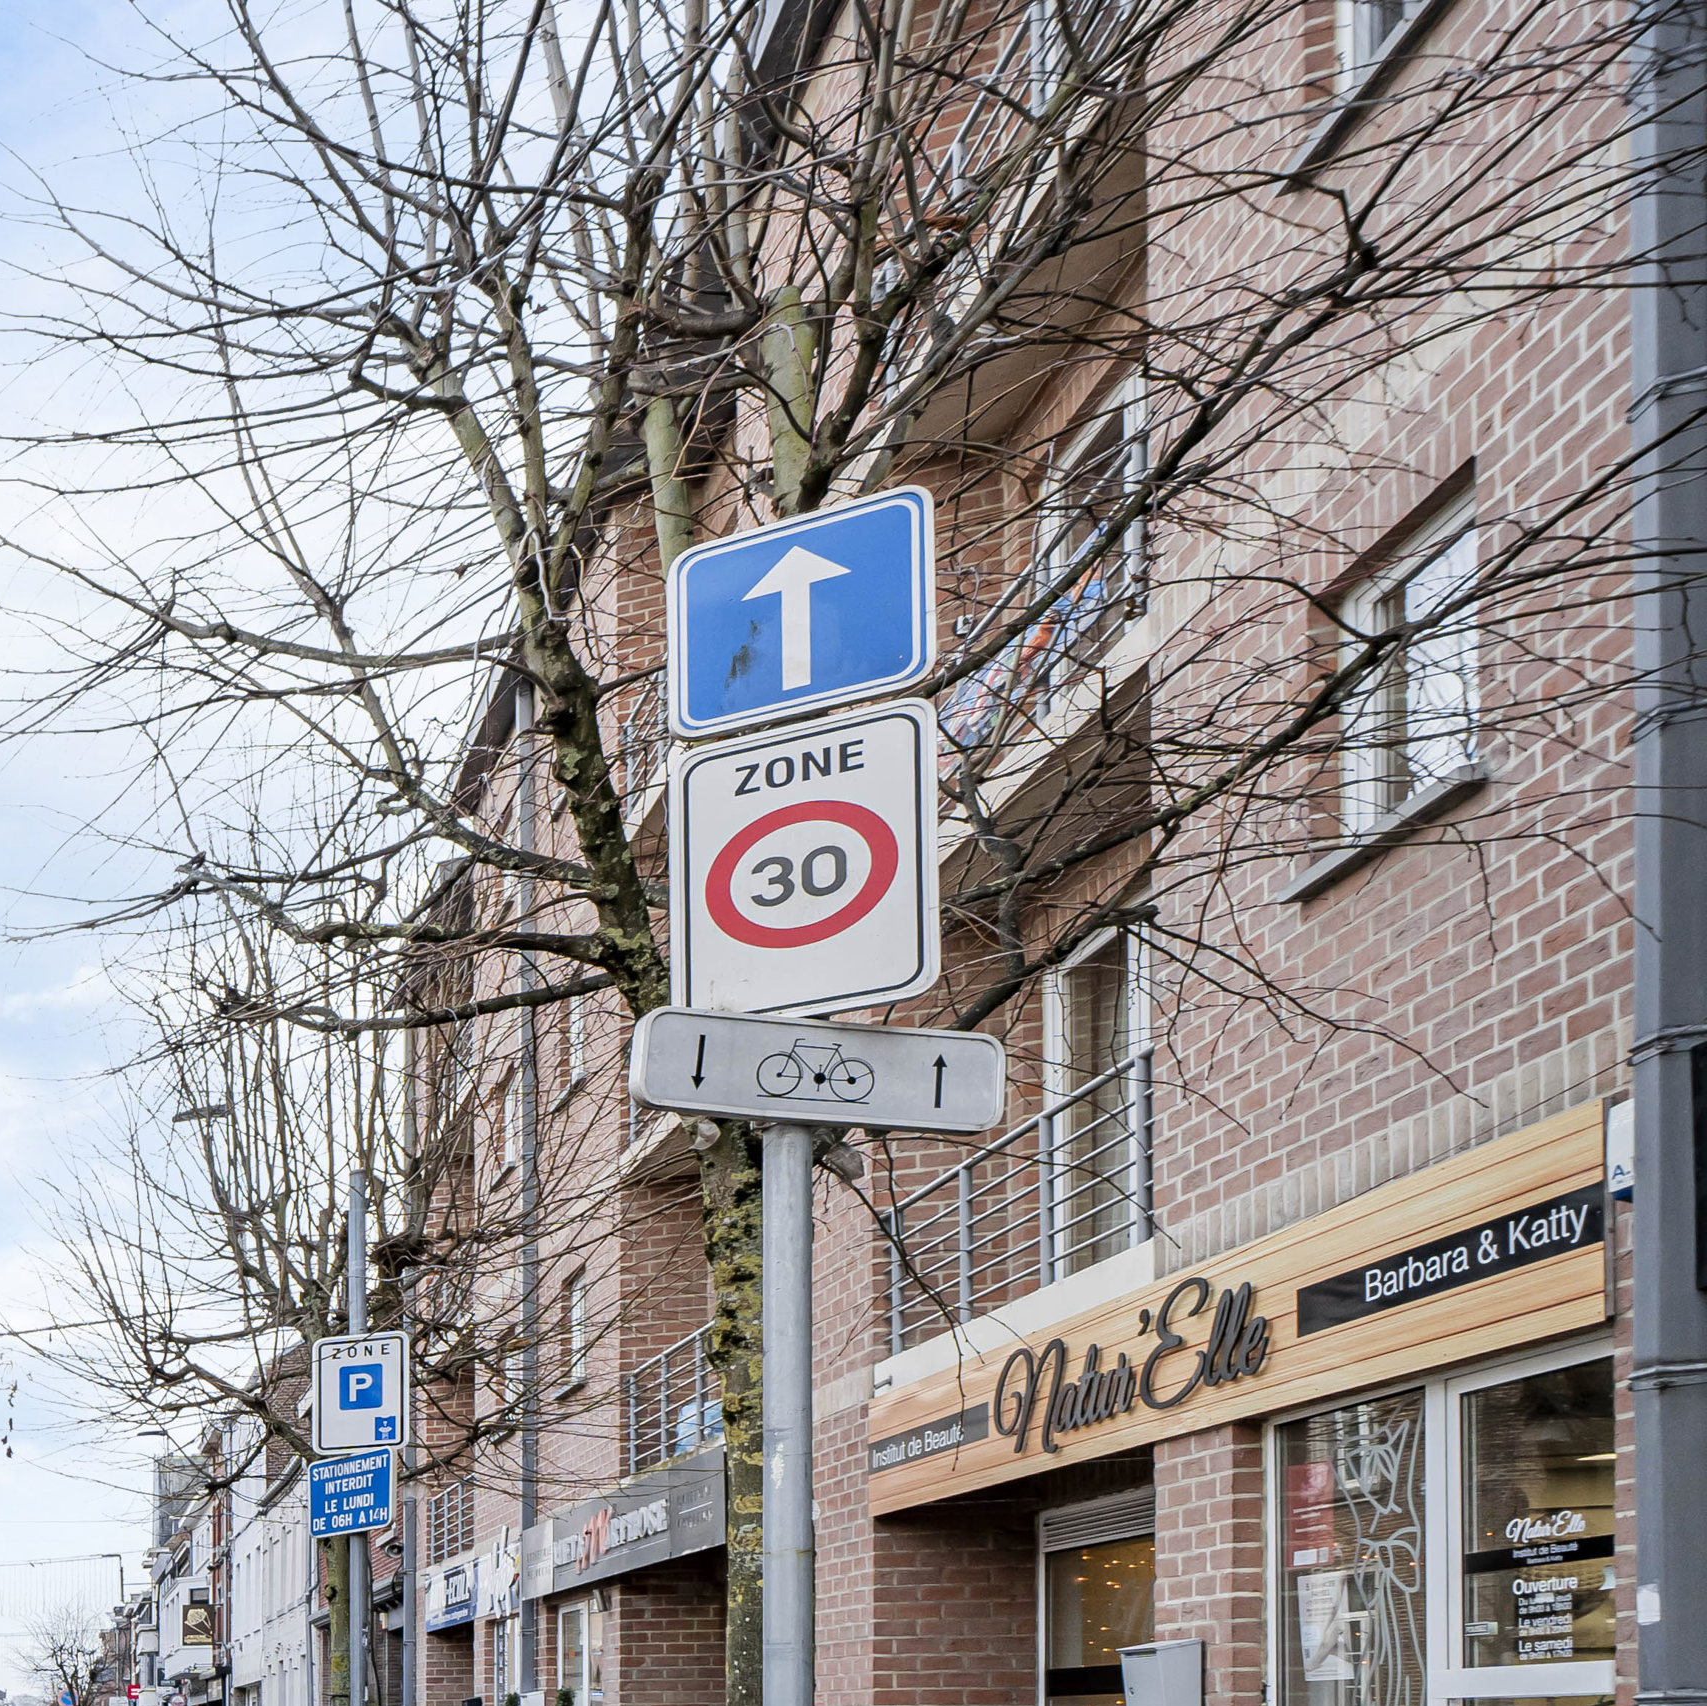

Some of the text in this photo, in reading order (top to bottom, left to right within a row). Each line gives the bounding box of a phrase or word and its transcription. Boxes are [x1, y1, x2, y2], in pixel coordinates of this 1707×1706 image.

[734, 738, 865, 797] ZONE
[750, 845, 847, 908] 30
[1365, 1204, 1589, 1303] Barbara & Katty
[331, 1343, 391, 1360] ZONE
[348, 1372, 374, 1403] P
[908, 1436, 923, 1458] de
[924, 1420, 965, 1452] Beauté
[312, 1454, 390, 1482] STATIONNEMENT
[324, 1473, 375, 1496] INTERDIT
[324, 1493, 374, 1515] LE LUNDI
[312, 1506, 388, 1532] DE 06H A 14H
[1512, 1576, 1579, 1596] Ouverture
[1518, 1613, 1573, 1628] Le vendredi
[1518, 1635, 1574, 1653] Le samedi
